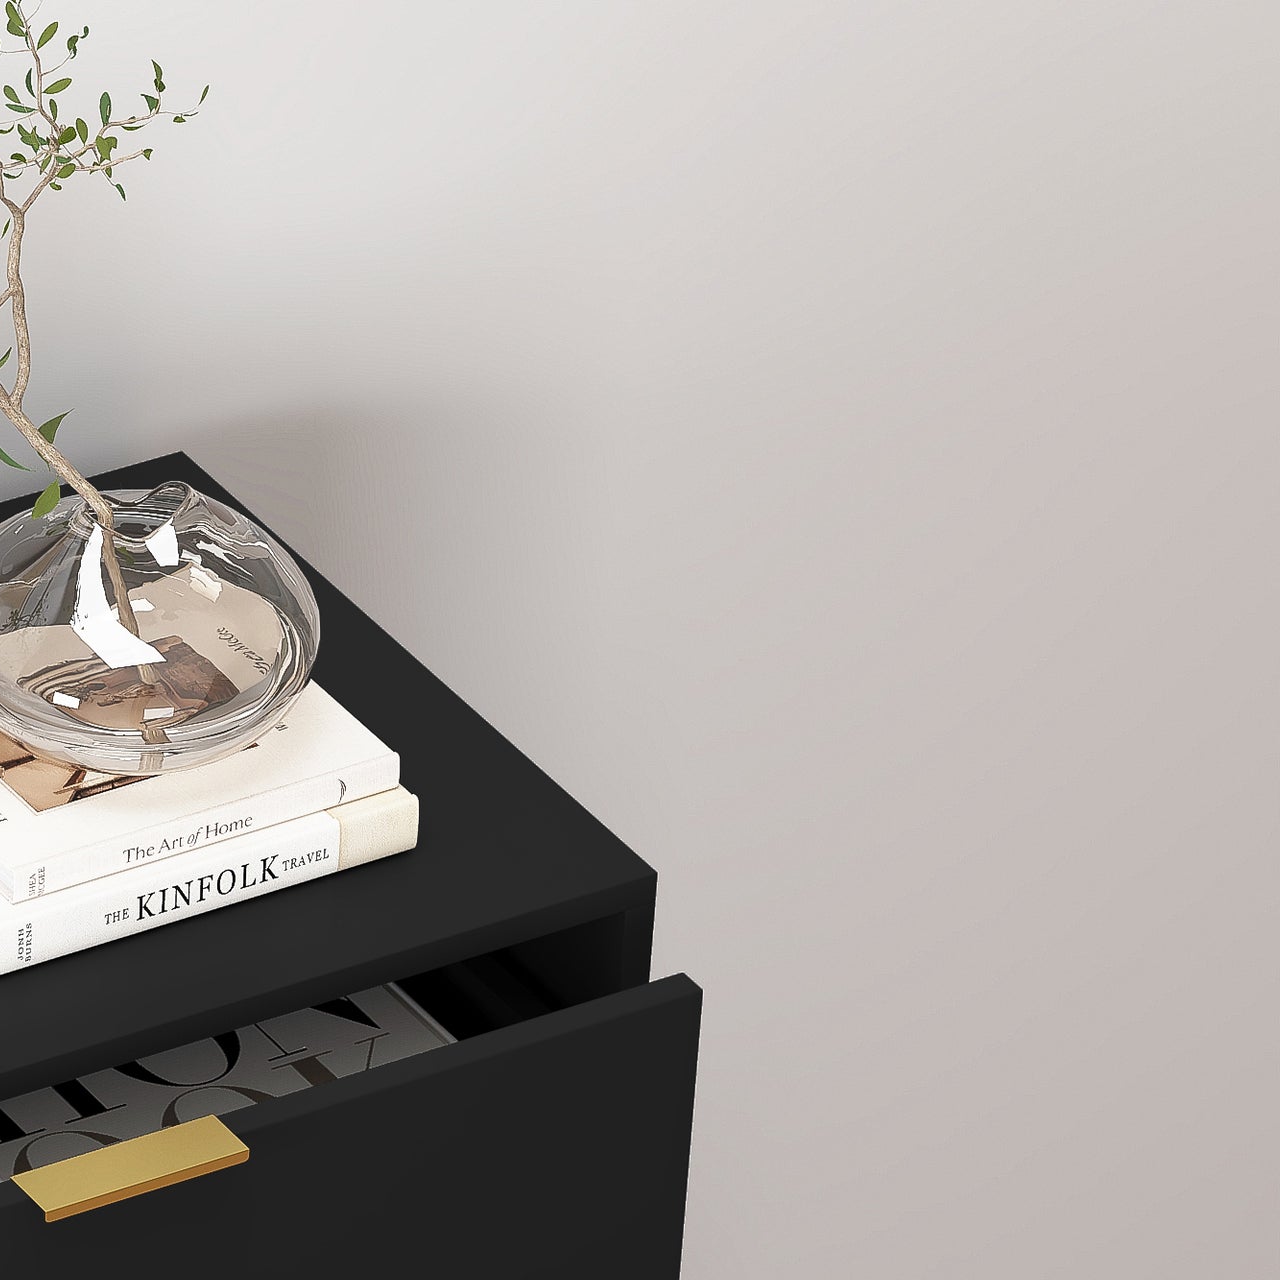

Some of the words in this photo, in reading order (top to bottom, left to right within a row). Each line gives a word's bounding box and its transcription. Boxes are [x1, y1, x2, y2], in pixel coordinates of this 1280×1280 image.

[123, 847, 155, 863] The
[158, 835, 184, 854] Art
[186, 826, 203, 847] of
[205, 815, 254, 840] Home
[104, 907, 131, 926] THE
[136, 853, 281, 922] KINFOLK
[282, 847, 330, 872] TRAVEL
[24, 922, 33, 963] BURNS
